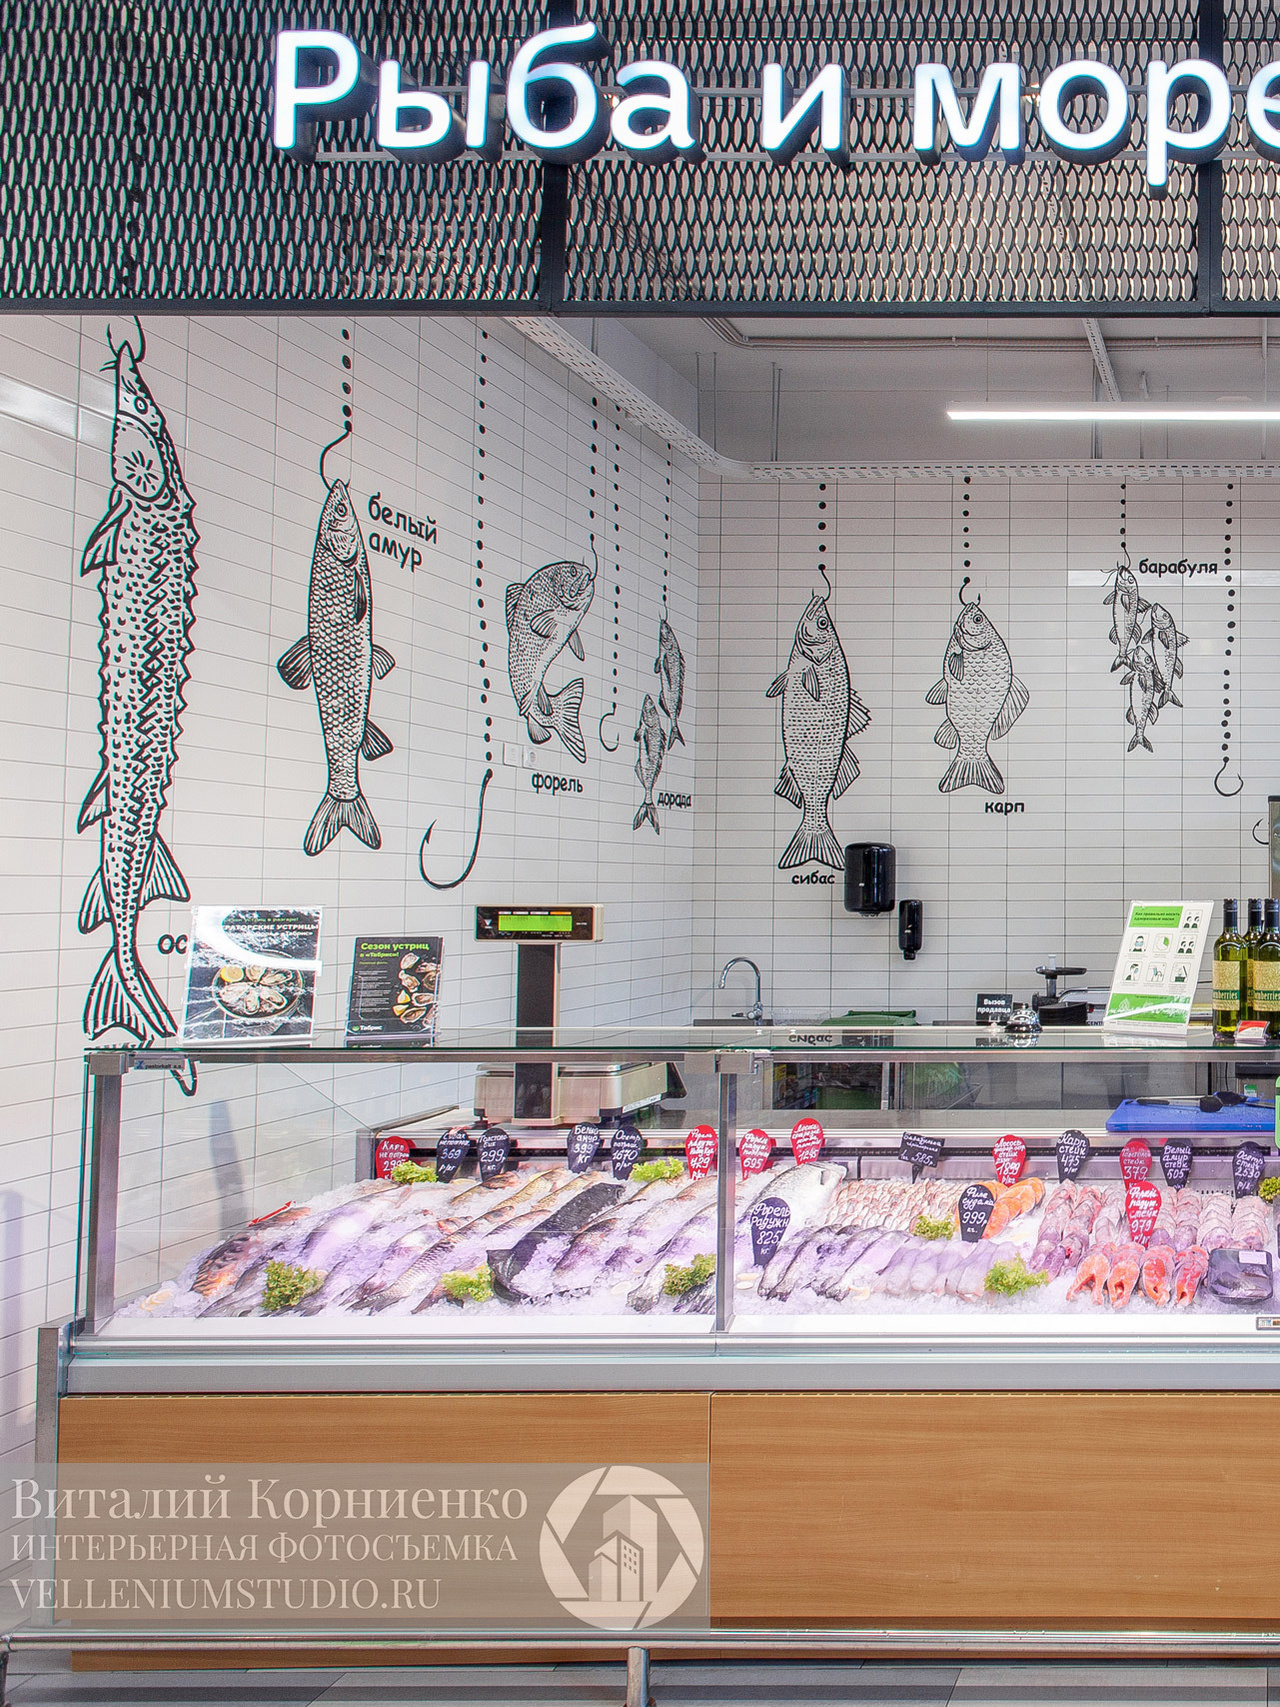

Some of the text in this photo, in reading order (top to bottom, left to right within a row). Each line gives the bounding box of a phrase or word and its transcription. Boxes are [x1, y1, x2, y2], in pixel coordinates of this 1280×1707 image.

[275, 22, 697, 151] Рыба
[762, 62, 843, 150] и
[368, 492, 437, 545] белый
[368, 533, 422, 572] амур
[1139, 559, 1218, 577] барабуля
[531, 771, 584, 796] форель
[656, 792, 692, 809] дорада
[985, 801, 1025, 816] карп
[791, 871, 836, 886] сибас
[361, 942, 430, 951] Сезон устриц
[1057, 1133, 1087, 1148] Карп
[441, 1148, 462, 1160] 369
[1058, 1145, 1086, 1155] стейк
[743, 1157, 764, 1169] 695
[1163, 1154, 1189, 1164] амур
[1235, 1167, 1261, 1178] 2530
[966, 1187, 988, 1199] Филе
[752, 1202, 791, 1217] Форель
[962, 1197, 995, 1211] судака
[751, 1217, 789, 1230] Радужн
[1131, 1219, 1152, 1233] 979
[757, 1230, 782, 1245] 825
